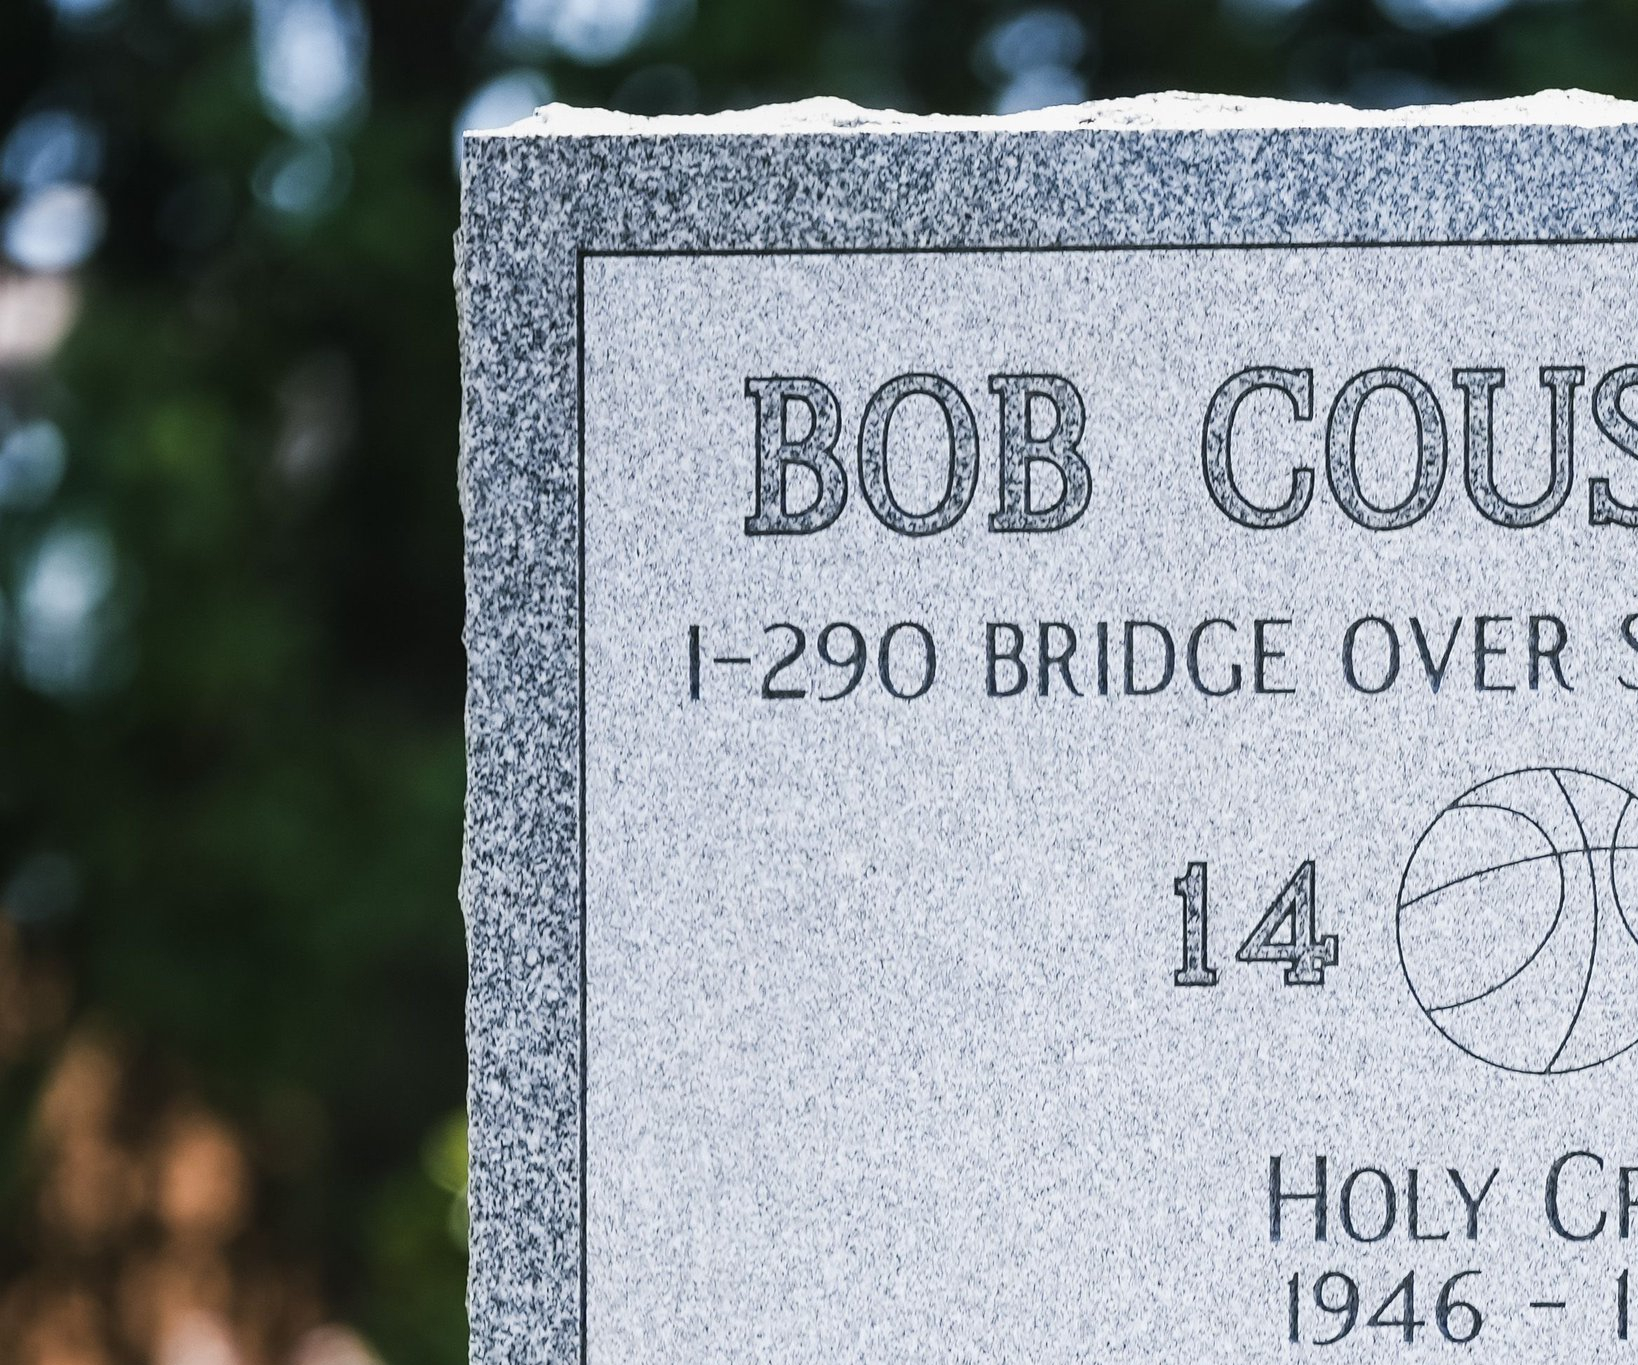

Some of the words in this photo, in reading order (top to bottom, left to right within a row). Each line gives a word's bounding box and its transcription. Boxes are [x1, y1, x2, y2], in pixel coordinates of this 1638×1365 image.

[743, 370, 1094, 540] BOB
[687, 620, 937, 703] I-290
[985, 617, 1296, 699] BRIDGE
[1341, 613, 1574, 696] OVER
[1172, 858, 1340, 989] 14
[1288, 1269, 1484, 1347] 1946
